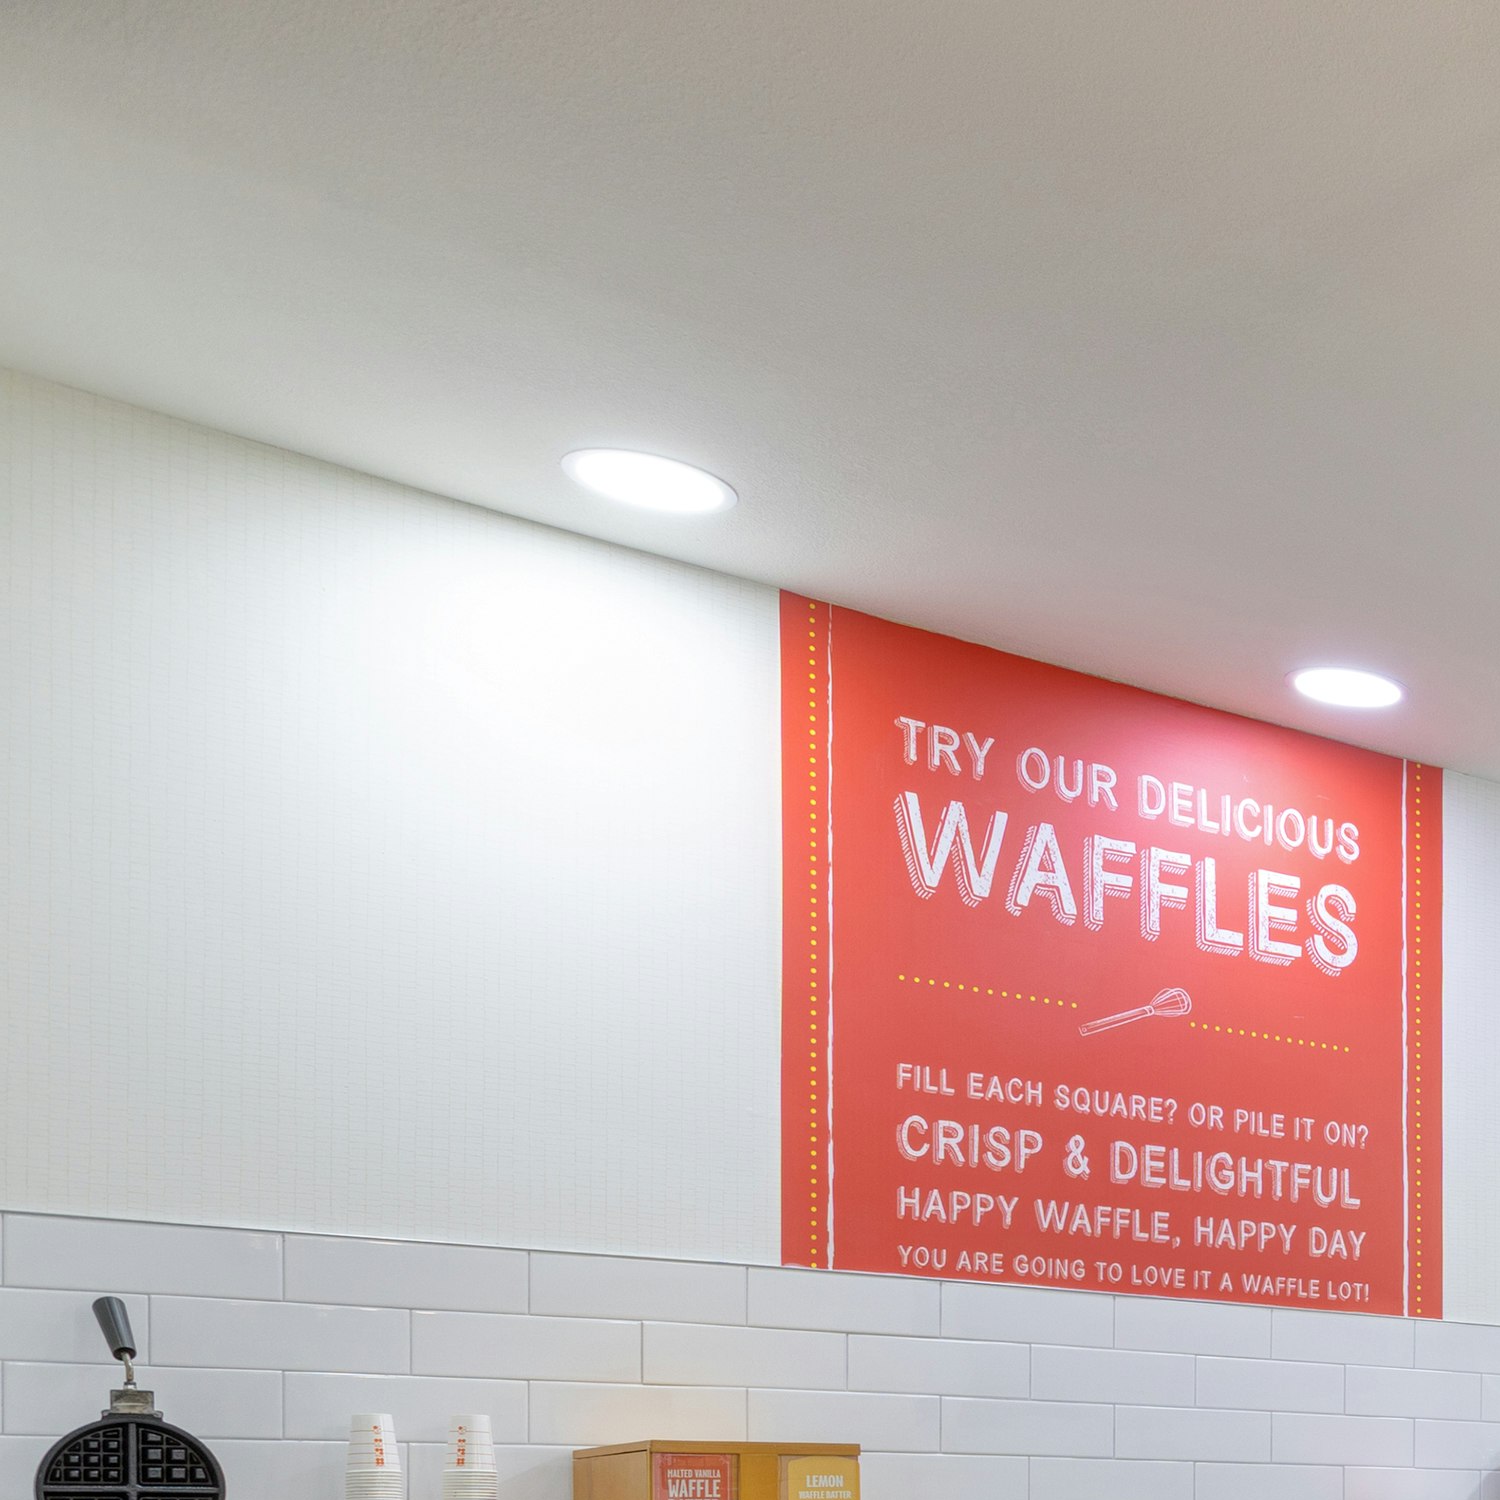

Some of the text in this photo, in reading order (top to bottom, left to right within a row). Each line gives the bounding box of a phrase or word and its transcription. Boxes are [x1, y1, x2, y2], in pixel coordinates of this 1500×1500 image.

[894, 716, 1360, 864] TRY OUR DELICIOUS
[893, 791, 1358, 977] WAFFLES
[897, 1063, 1369, 1149] FILL EACH SQUARE? OR PILE IT ON?
[896, 1115, 1361, 1209] CRISP & DELIGHTFUL
[897, 1186, 1366, 1261] HAPPY WAFFLE, HAPPY DAY
[898, 1245, 1370, 1302] YOU ARE GOING TO LOVE IT A WAFFLE LOT!
[667, 1469, 721, 1478] MALTED VANILLA
[668, 1479, 721, 1498] WAFFLE
[798, 1491, 852, 1499] WAFFLE BATTER
[806, 1475, 844, 1488] LEMON
